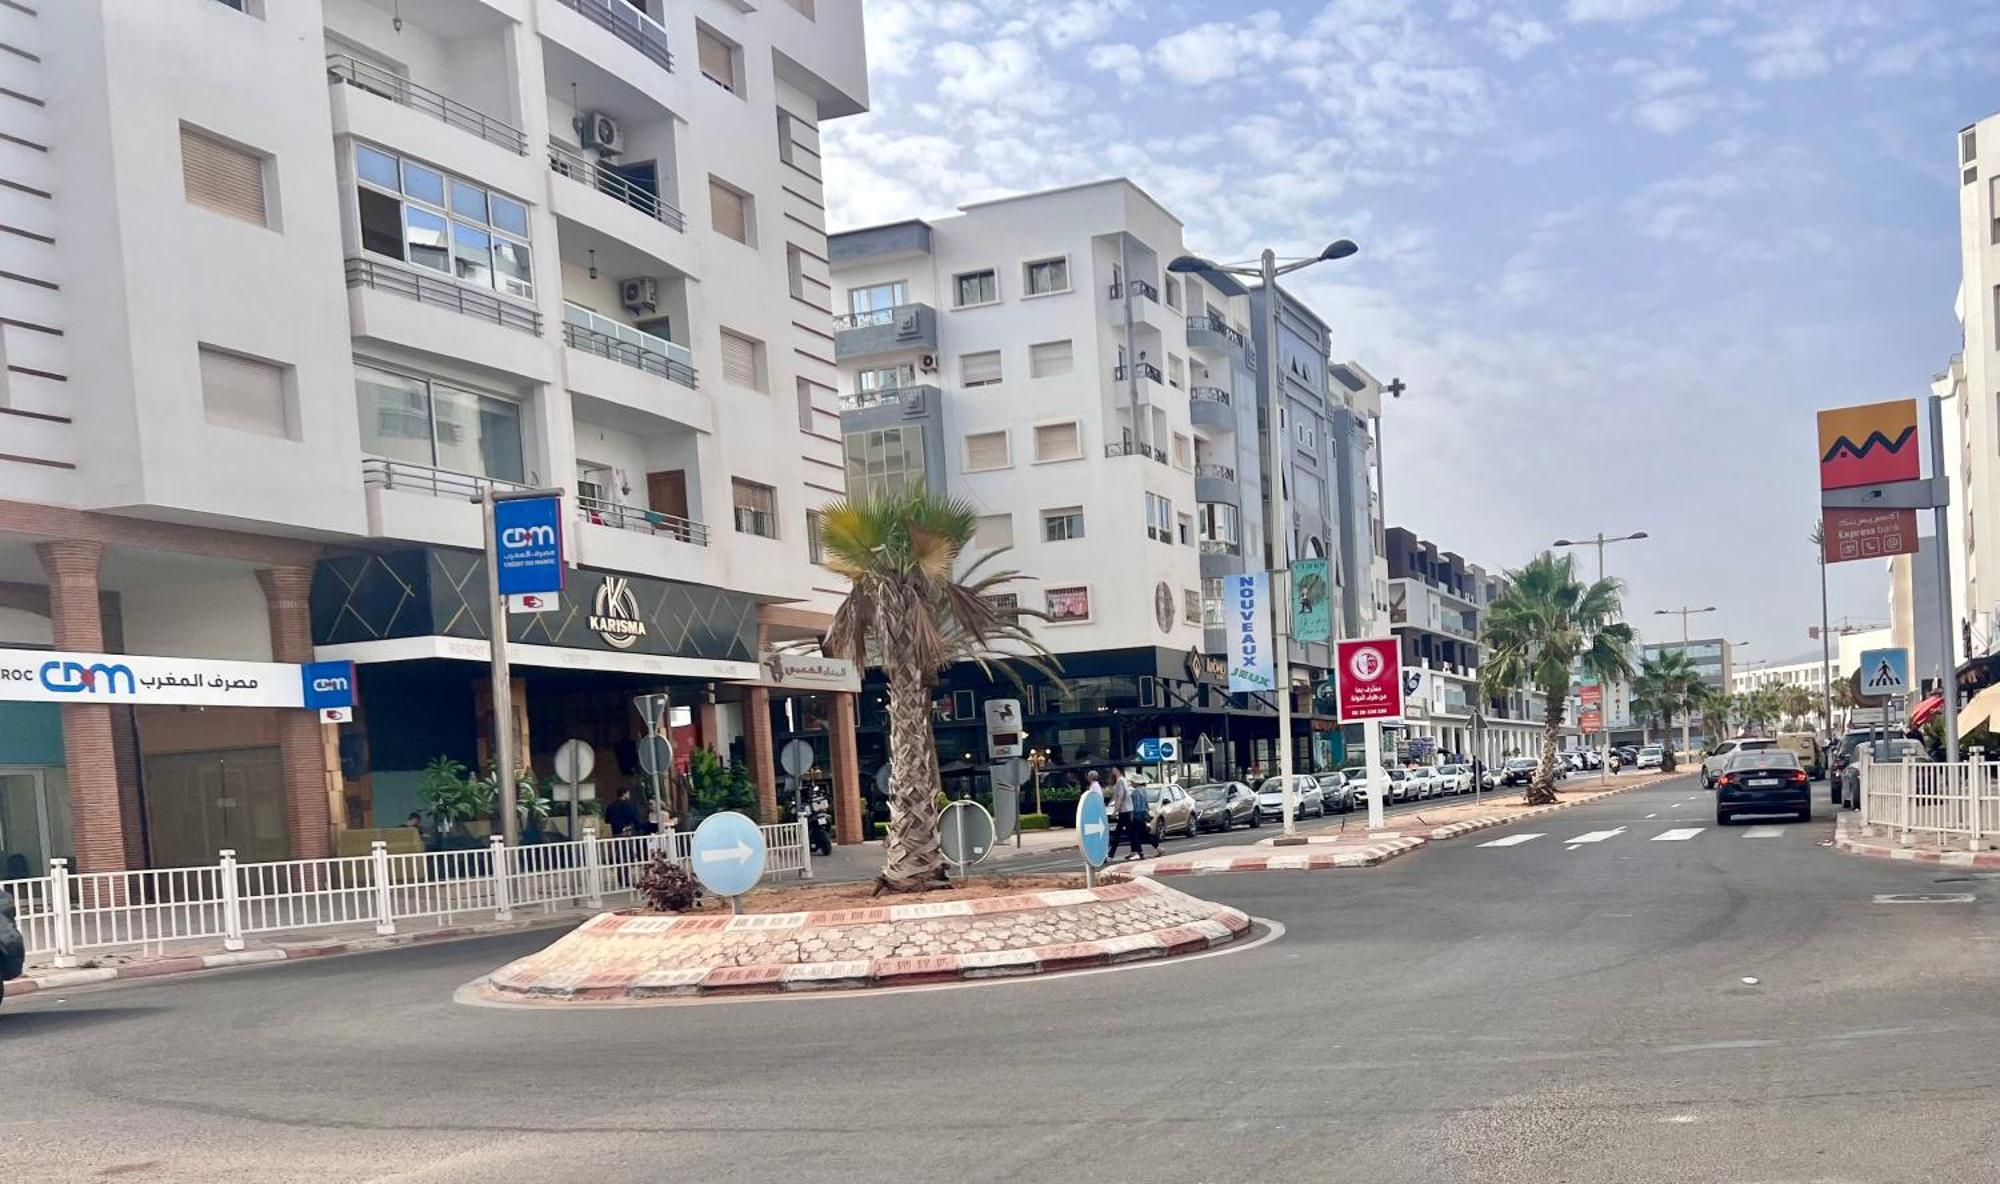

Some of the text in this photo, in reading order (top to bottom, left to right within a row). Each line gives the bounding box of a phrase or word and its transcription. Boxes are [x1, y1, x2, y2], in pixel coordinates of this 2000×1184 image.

[1838, 522, 1900, 540] Express bank
[589, 615, 647, 636] KARISMA
[1239, 576, 1257, 667] NOUVEAUX
[139, 674, 258, 691] مصرف المغرب
[1231, 667, 1271, 687] JEUX
